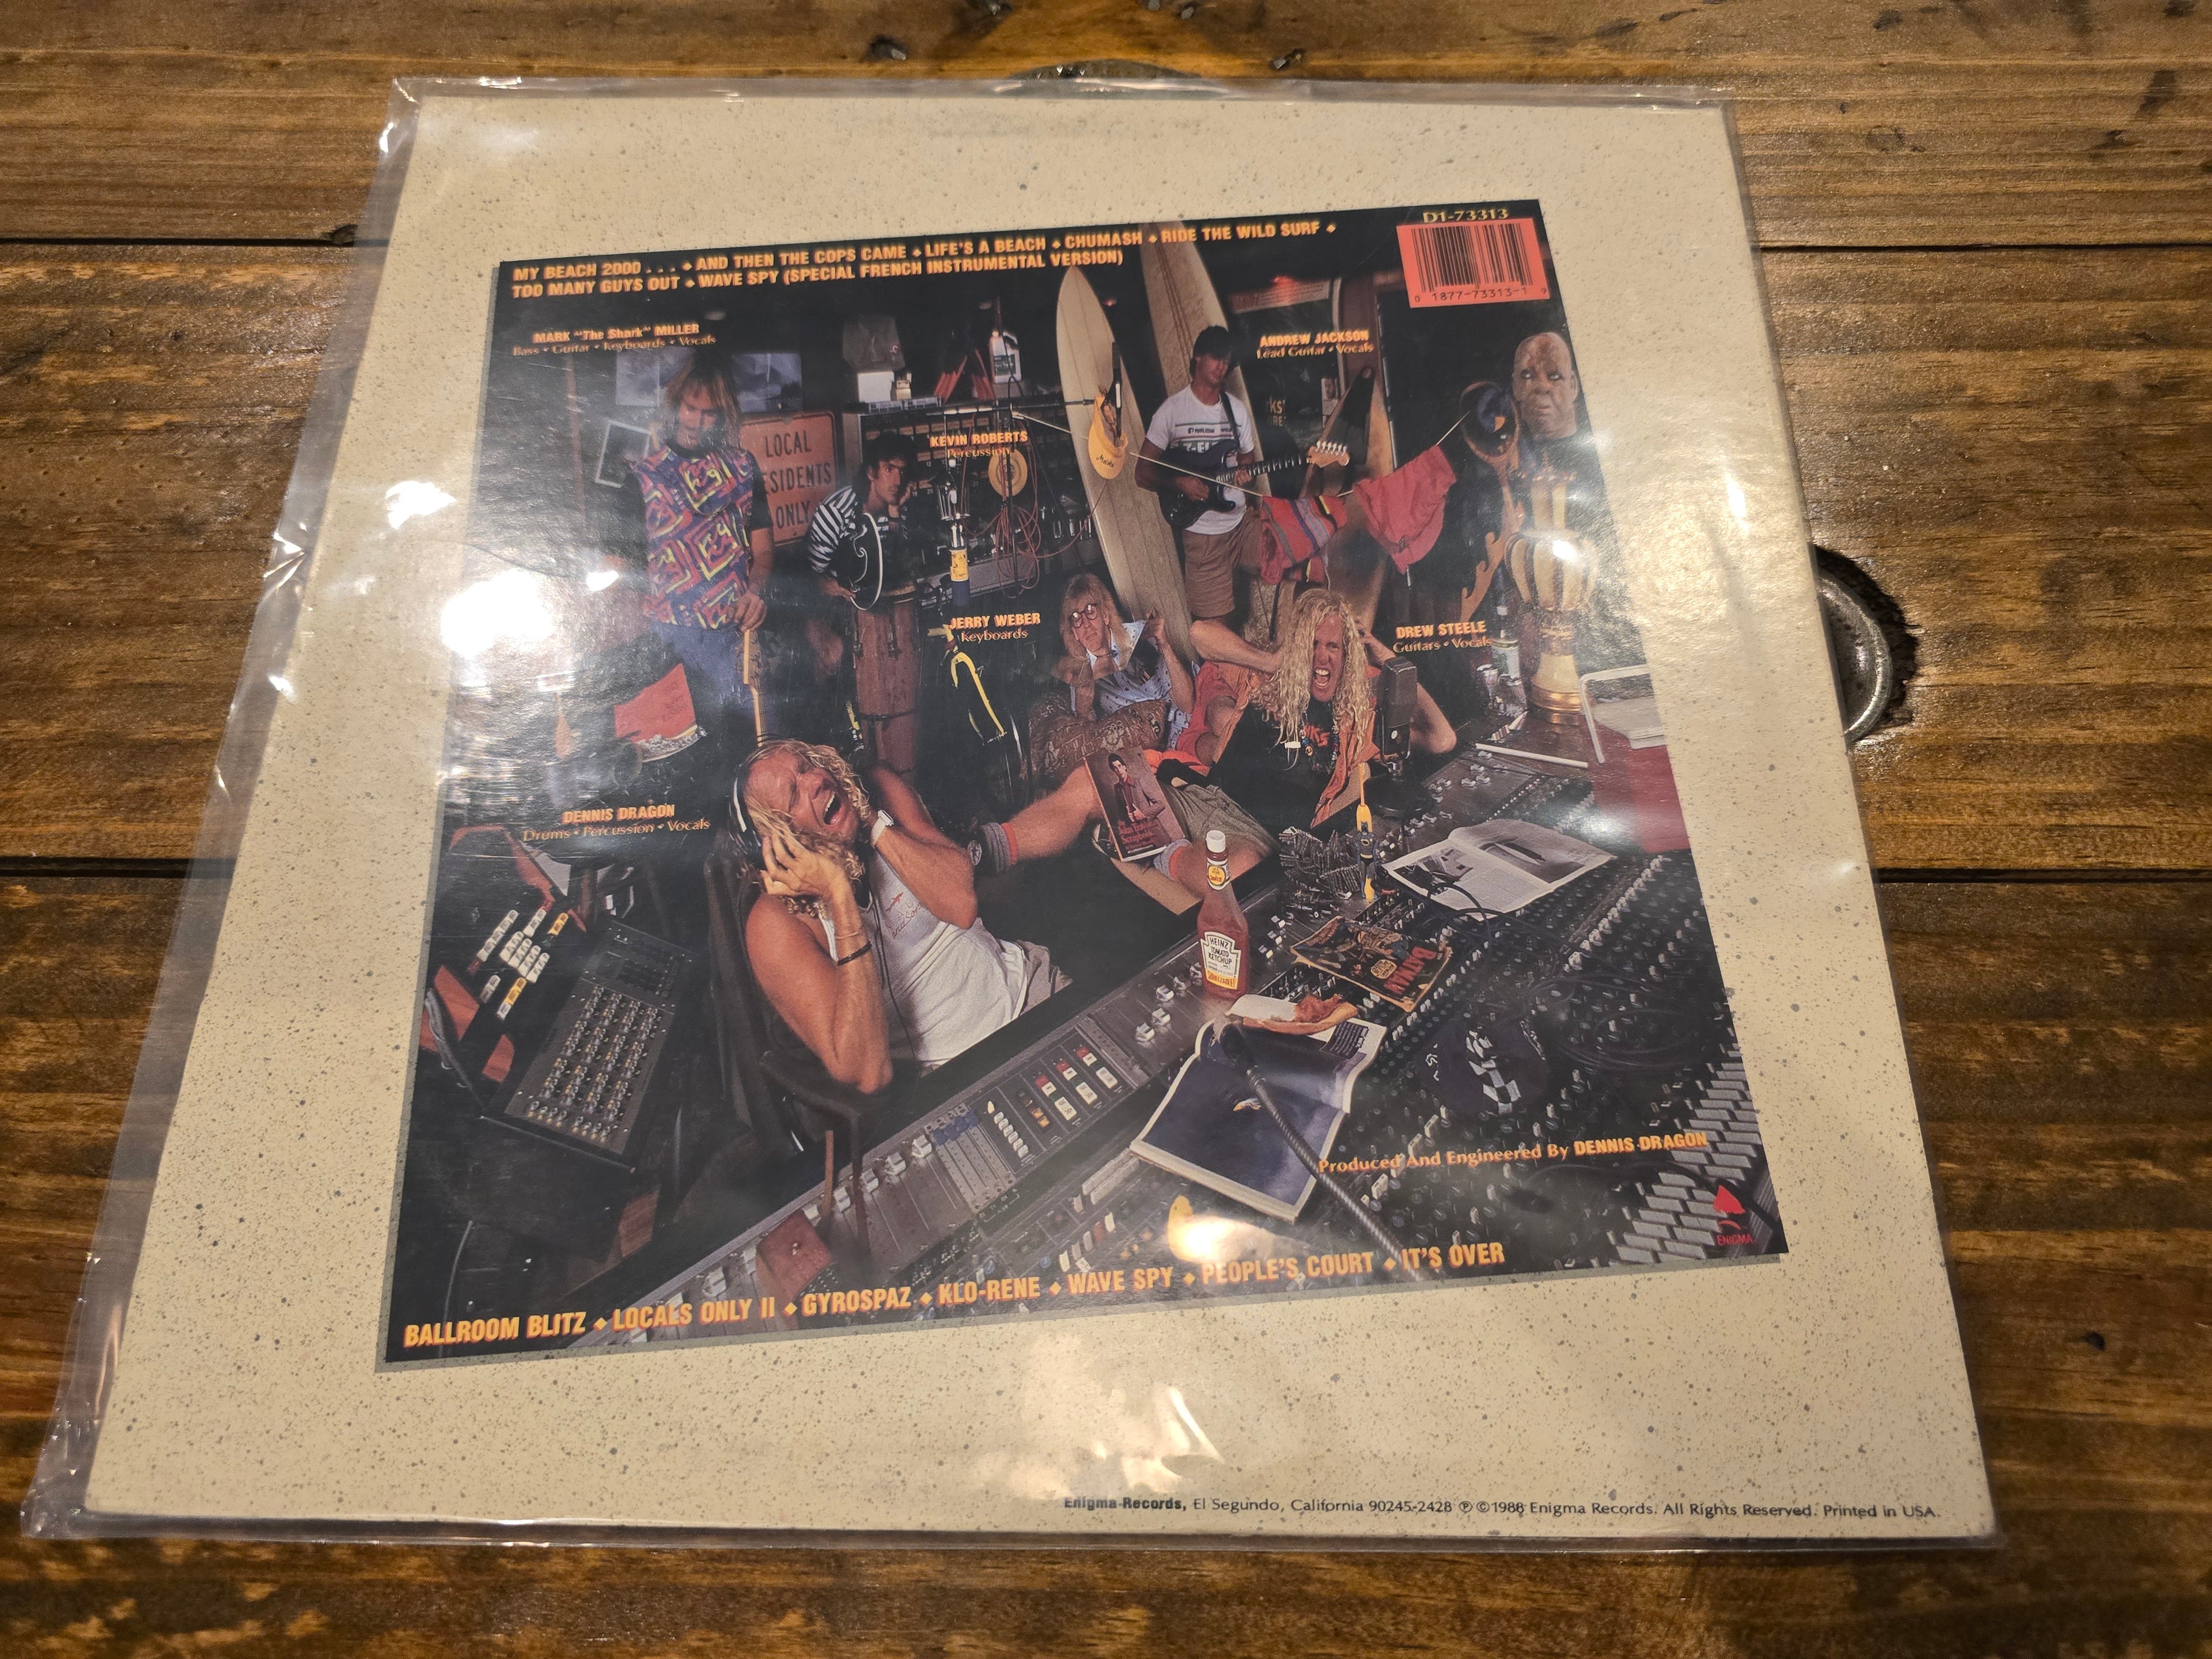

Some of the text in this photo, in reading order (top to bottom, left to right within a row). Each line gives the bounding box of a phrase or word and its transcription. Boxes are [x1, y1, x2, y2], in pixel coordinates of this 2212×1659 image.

[1423, 208, 1509, 223] D1-73313
[513, 267, 539, 281] MY
[544, 263, 597, 280] BEACH
[601, 262, 641, 276] 2000
[696, 256, 728, 271] AND
[733, 253, 774, 268] THEN
[779, 251, 809, 266] THE
[814, 249, 857, 264] COPS
[863, 246, 906, 260] CAME
[925, 240, 974, 257] LIFE'S
[979, 240, 990, 253] A
[995, 236, 1046, 253] BEACH
[1065, 232, 1143, 249] CHUMASH
[1161, 229, 1198, 244] RIDE
[1202, 227, 1232, 241] THE
[1236, 225, 1277, 239] WILD
[1281, 222, 1320, 236] SURF
[512, 250, 1123, 298] TOO MANY GUYS OUT WAVE SPY (SPECIAL FRENCH INSTRUMENTAL VERSION)
[533, 332, 570, 343] MARK
[654, 323, 700, 336] MILLER
[1259, 330, 1370, 347] ANDREW JACKSON
[513, 346, 539, 355] Bass
[552, 344, 590, 354] Guitar
[679, 335, 717, 346] Vocals
[1256, 343, 1374, 359] Lead Guitar Vocals
[764, 430, 812, 458] LOCAL
[930, 431, 1028, 448] KEVIN ROBERTS
[947, 446, 1010, 459] Percussion
[764, 463, 831, 494] SIDENTS
[775, 501, 810, 529] ONLY
[949, 612, 1040, 630] JERRY WEBER
[1396, 620, 1486, 639] DREW STEELE
[961, 628, 1029, 644] Keyboards
[1393, 636, 1493, 653] Guitars Vocals
[561, 804, 675, 825] DENNIS DRAGON
[523, 817, 711, 842] Drums Percussion Vocals
[1210, 937, 1229, 949] HEINZ
[1211, 946, 1229, 957] TOMATO
[1209, 952, 1232, 965] KETCHUP
[1318, 1132, 1709, 1173] Produced And Engineered By DENNIS DRAGON
[1717, 1234, 1752, 1245] ENIGMA
[404, 1316, 518, 1348] BALLROOM
[527, 1311, 586, 1339] BLITZ
[611, 1303, 692, 1332] LOCALS
[699, 1298, 752, 1323] ONLY
[802, 1286, 912, 1317] GYROSPAZ
[938, 1277, 1040, 1306] KLO-RENE
[1067, 1270, 1126, 1296] WAVE
[1132, 1266, 1174, 1290] SPY
[1202, 1257, 1299, 1285] PEOPLE'S
[1306, 1251, 1374, 1278] COURT
[1400, 1246, 1442, 1270] IT'S
[1448, 1241, 1505, 1267] OVER
[1064, 1496, 1117, 1511] Enigma
[1123, 1497, 1187, 1512] Records,
[1194, 1498, 1206, 1509] El
[1212, 1498, 1285, 1513] Segundo,
[1291, 1498, 1363, 1513] California
[1369, 1499, 1452, 1513] 90245-2428
[1529, 1501, 1586, 1516] Enigma
[1592, 1502, 1658, 1515] Records.
[1663, 1501, 1684, 1515] All
[1690, 1502, 1737, 1518] Rights
[1743, 1502, 1816, 1517] Reserved.
[1824, 1503, 1877, 1518] Printed
[1883, 1504, 1896, 1517] in
[1902, 1504, 1940, 1518] USA.
